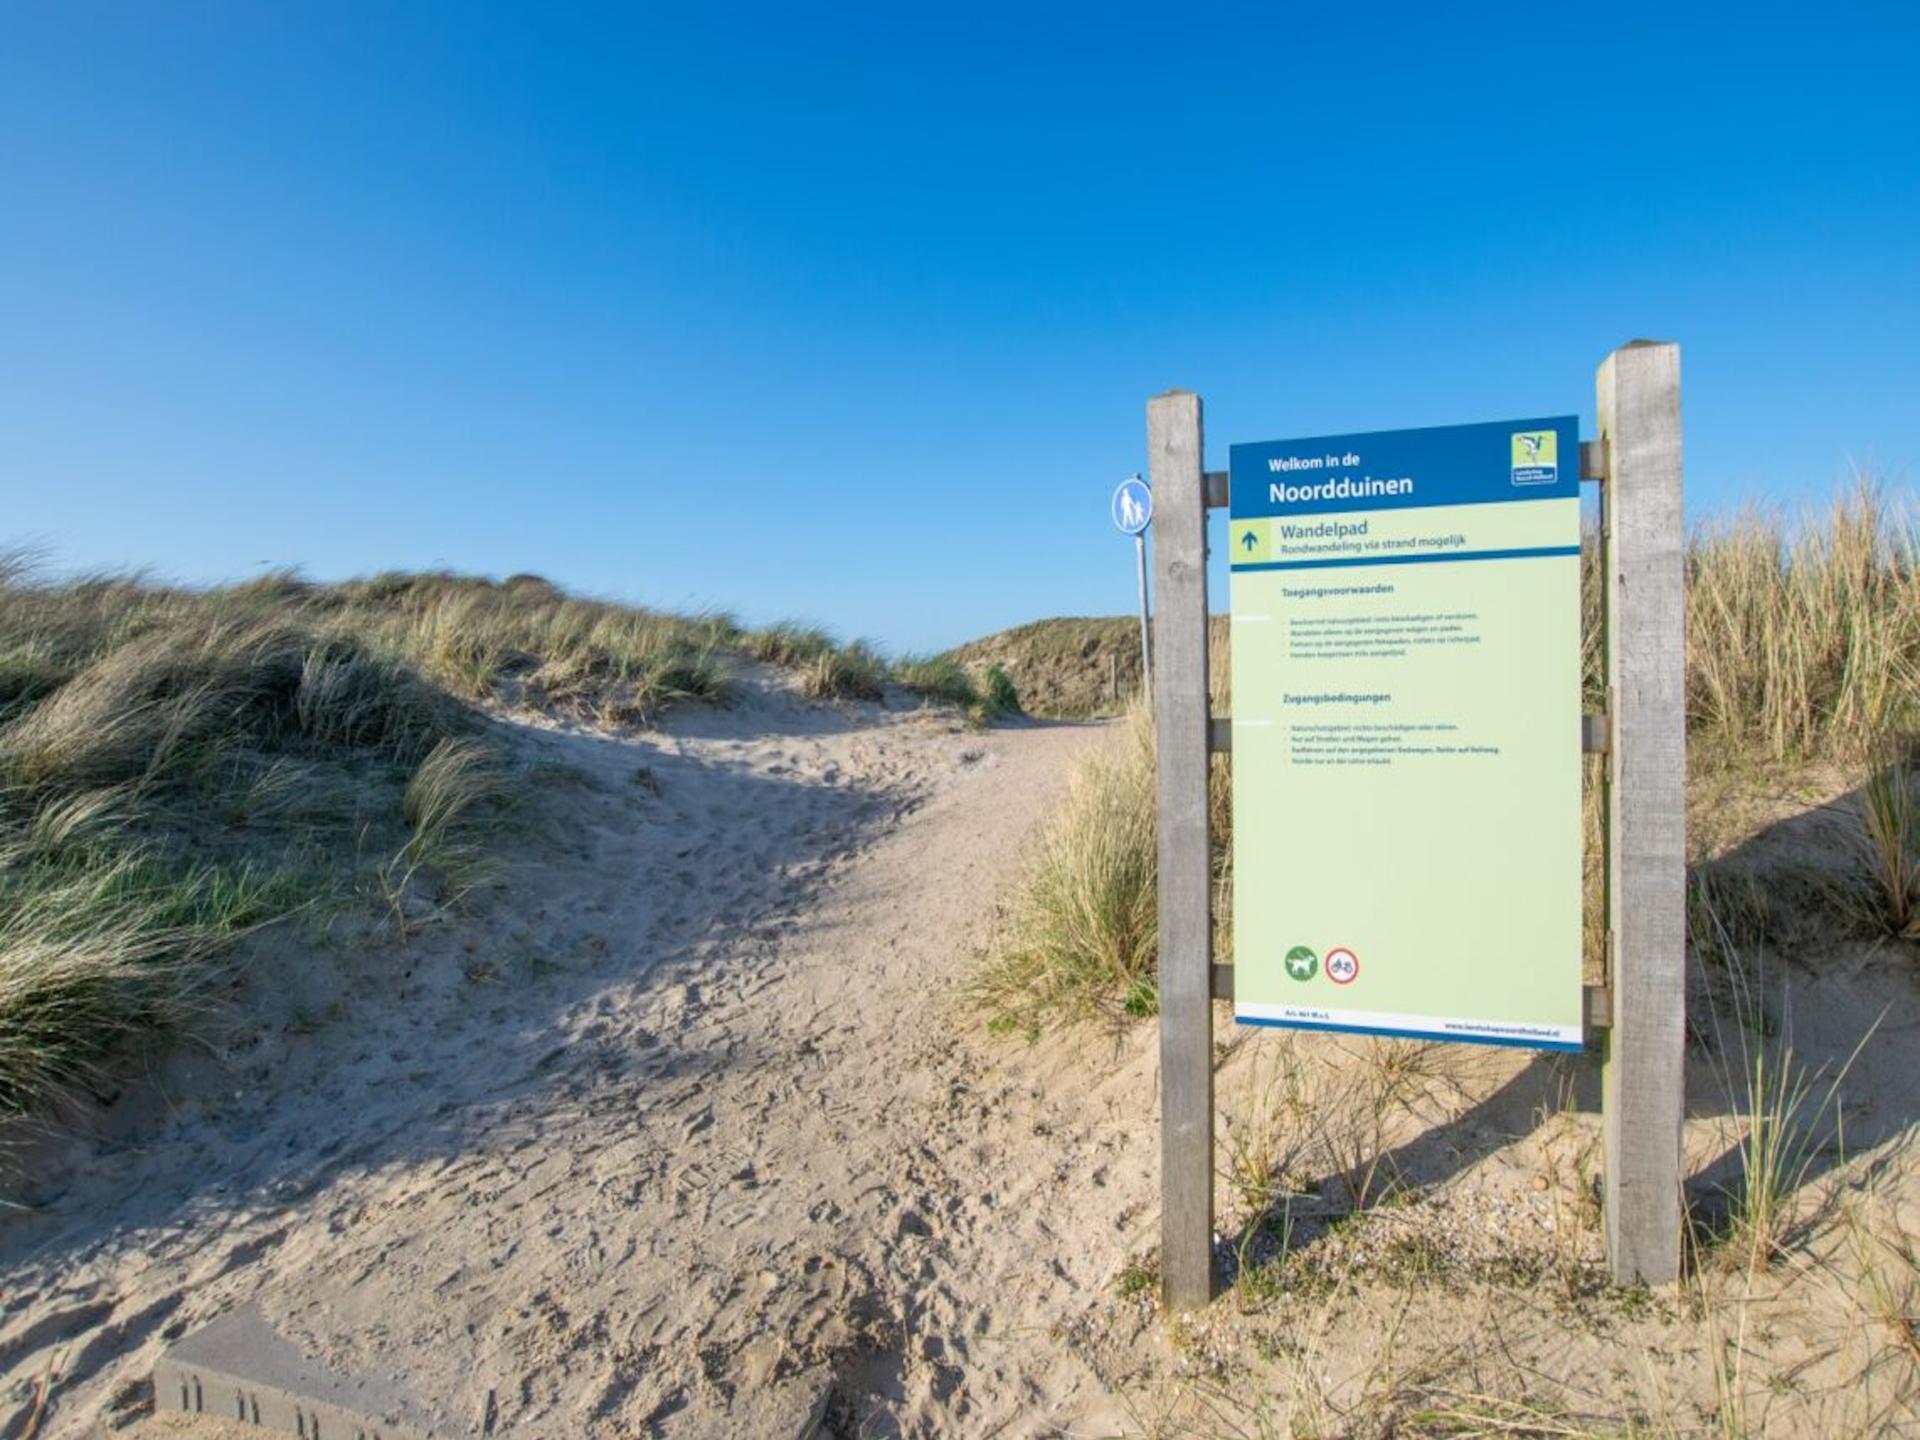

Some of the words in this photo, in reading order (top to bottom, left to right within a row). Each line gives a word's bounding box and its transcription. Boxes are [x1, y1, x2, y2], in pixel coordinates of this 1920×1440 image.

[1269, 455, 1322, 472] Welkom
[1326, 454, 1339, 467] in
[1342, 452, 1360, 466] de
[1269, 476, 1413, 503] Noordduinen
[1281, 519, 1368, 539] Wandelpad
[1281, 541, 1362, 554] Rondwandeling
[1364, 541, 1379, 550] via
[1382, 535, 1416, 549] strand
[1419, 533, 1466, 549] mogelijk
[1282, 583, 1394, 599] Toegangsvoorwaarden
[1283, 692, 1391, 705] Zugangsbedingungen
